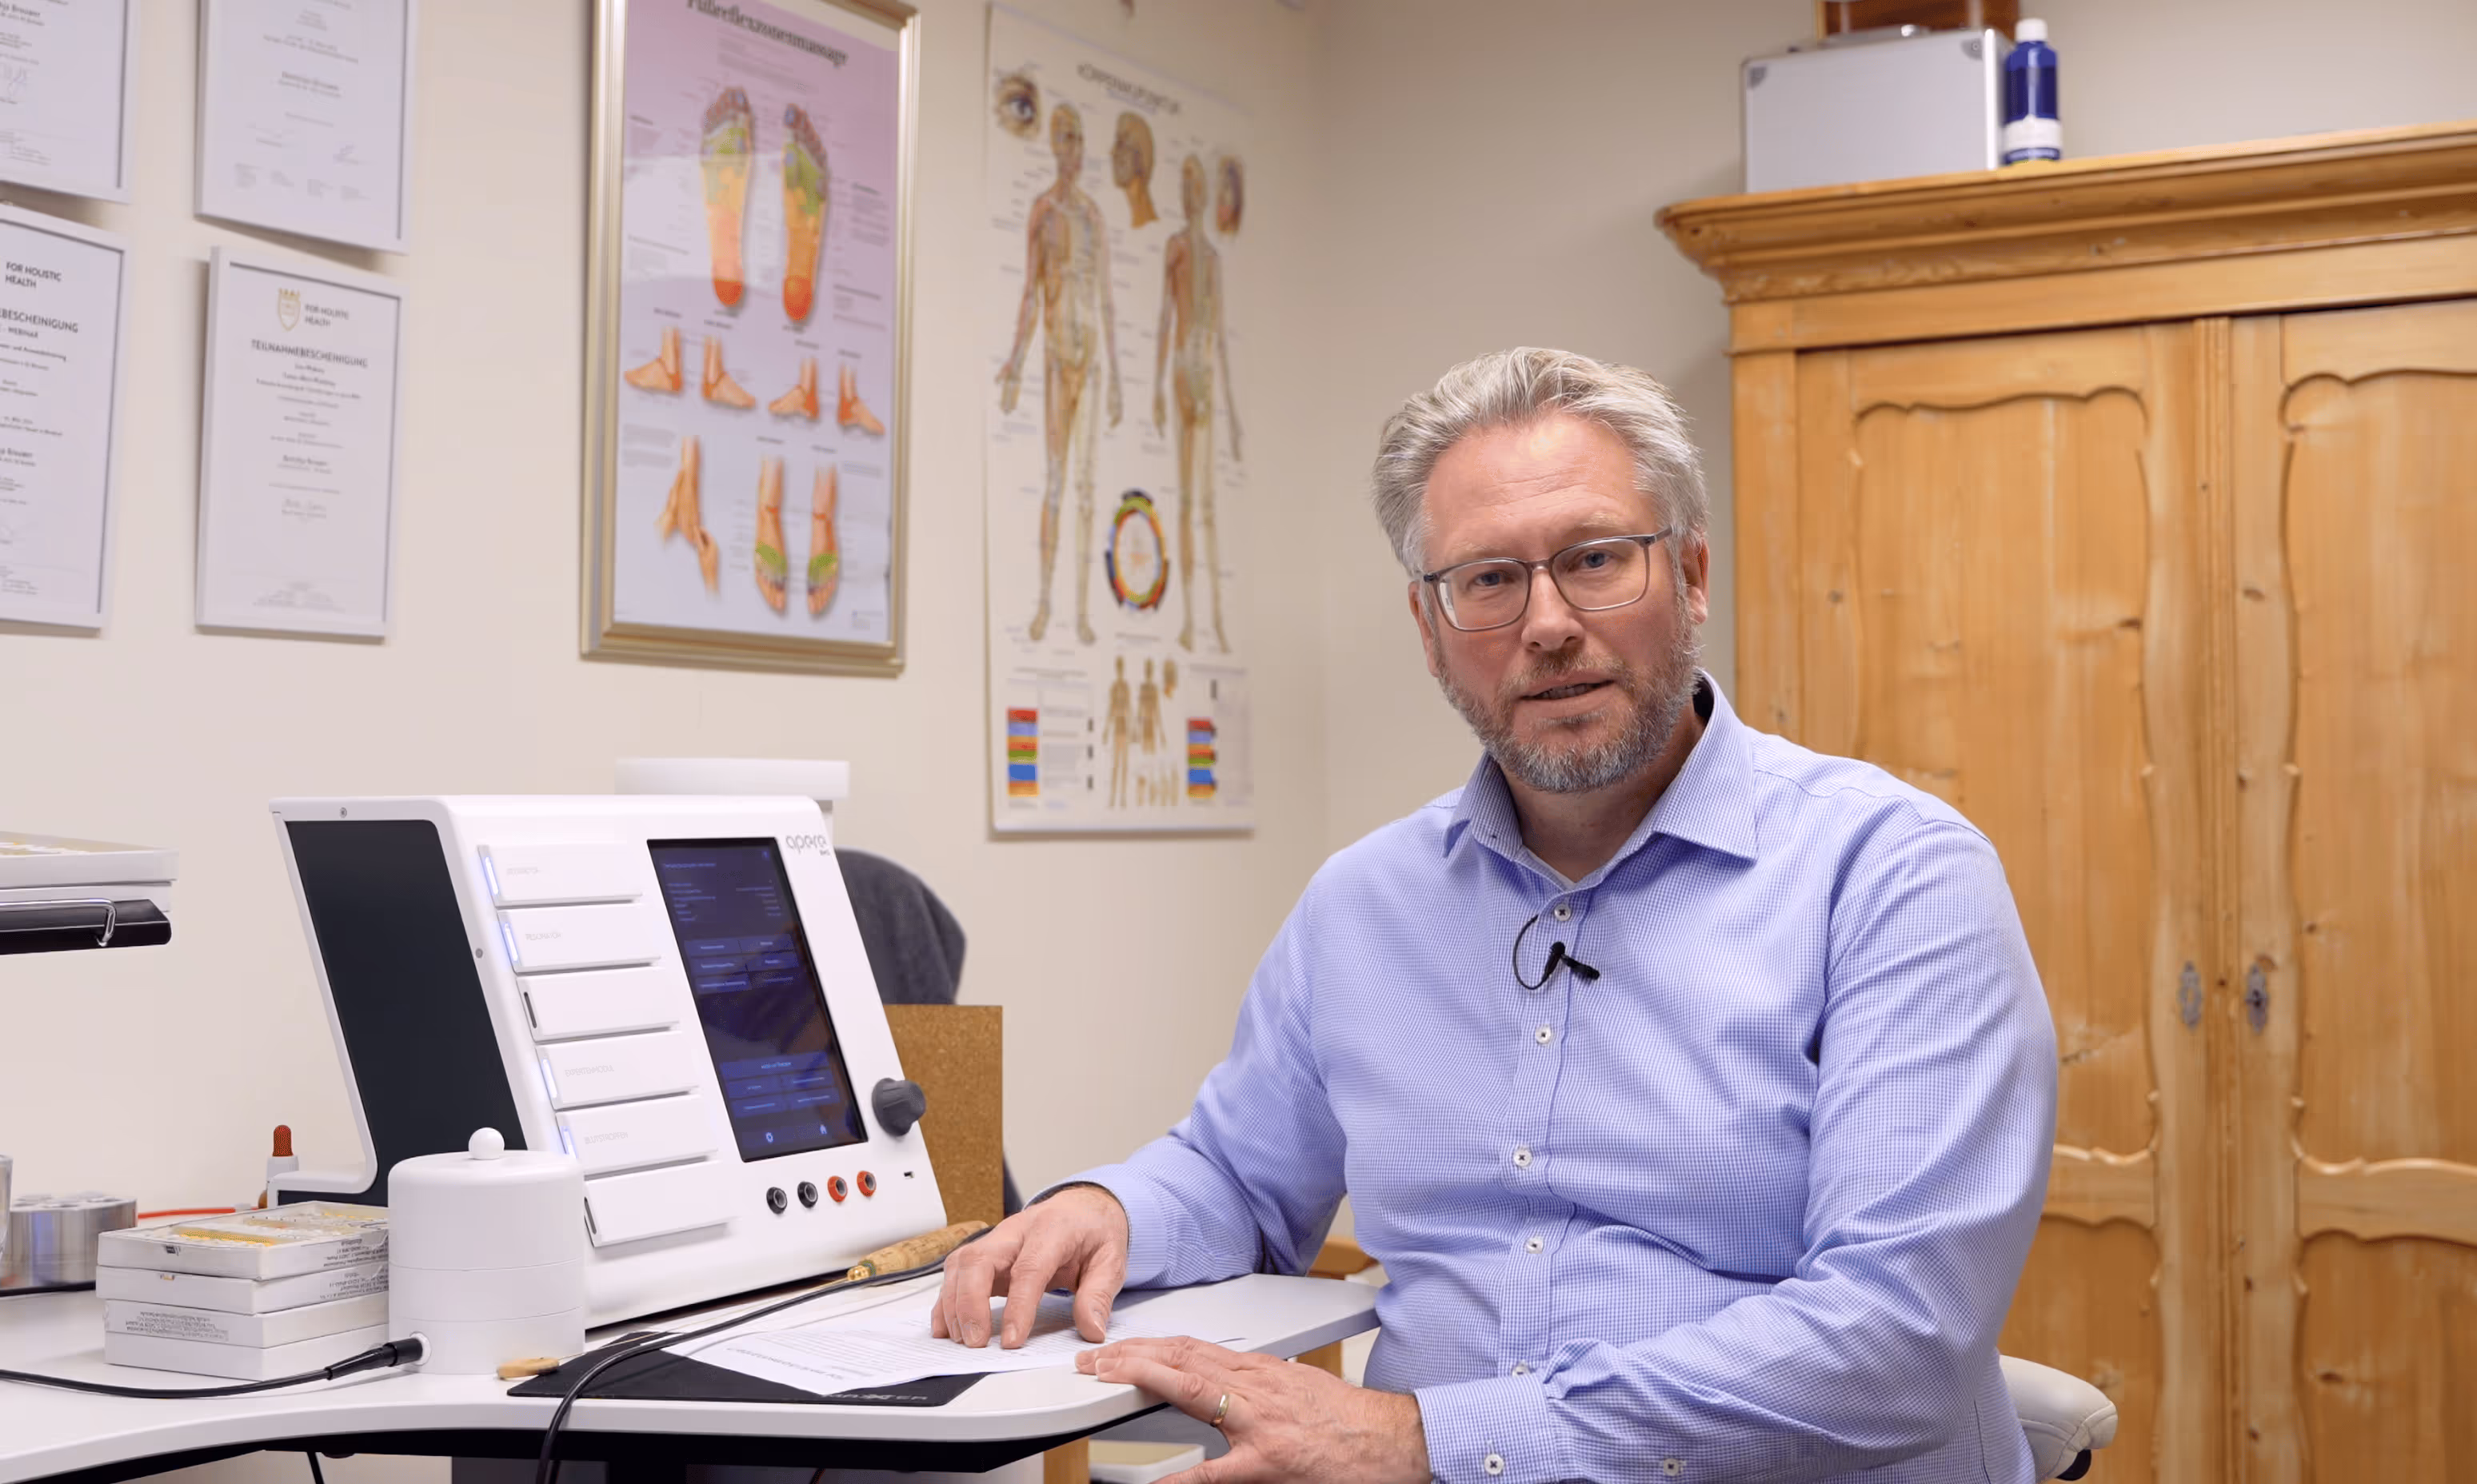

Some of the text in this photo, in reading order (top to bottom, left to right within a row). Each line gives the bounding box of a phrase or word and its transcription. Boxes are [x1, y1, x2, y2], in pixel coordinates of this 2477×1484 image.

[6, 261, 62, 281] FOR HOLISTIC
[5, 274, 37, 289] HEALTH
